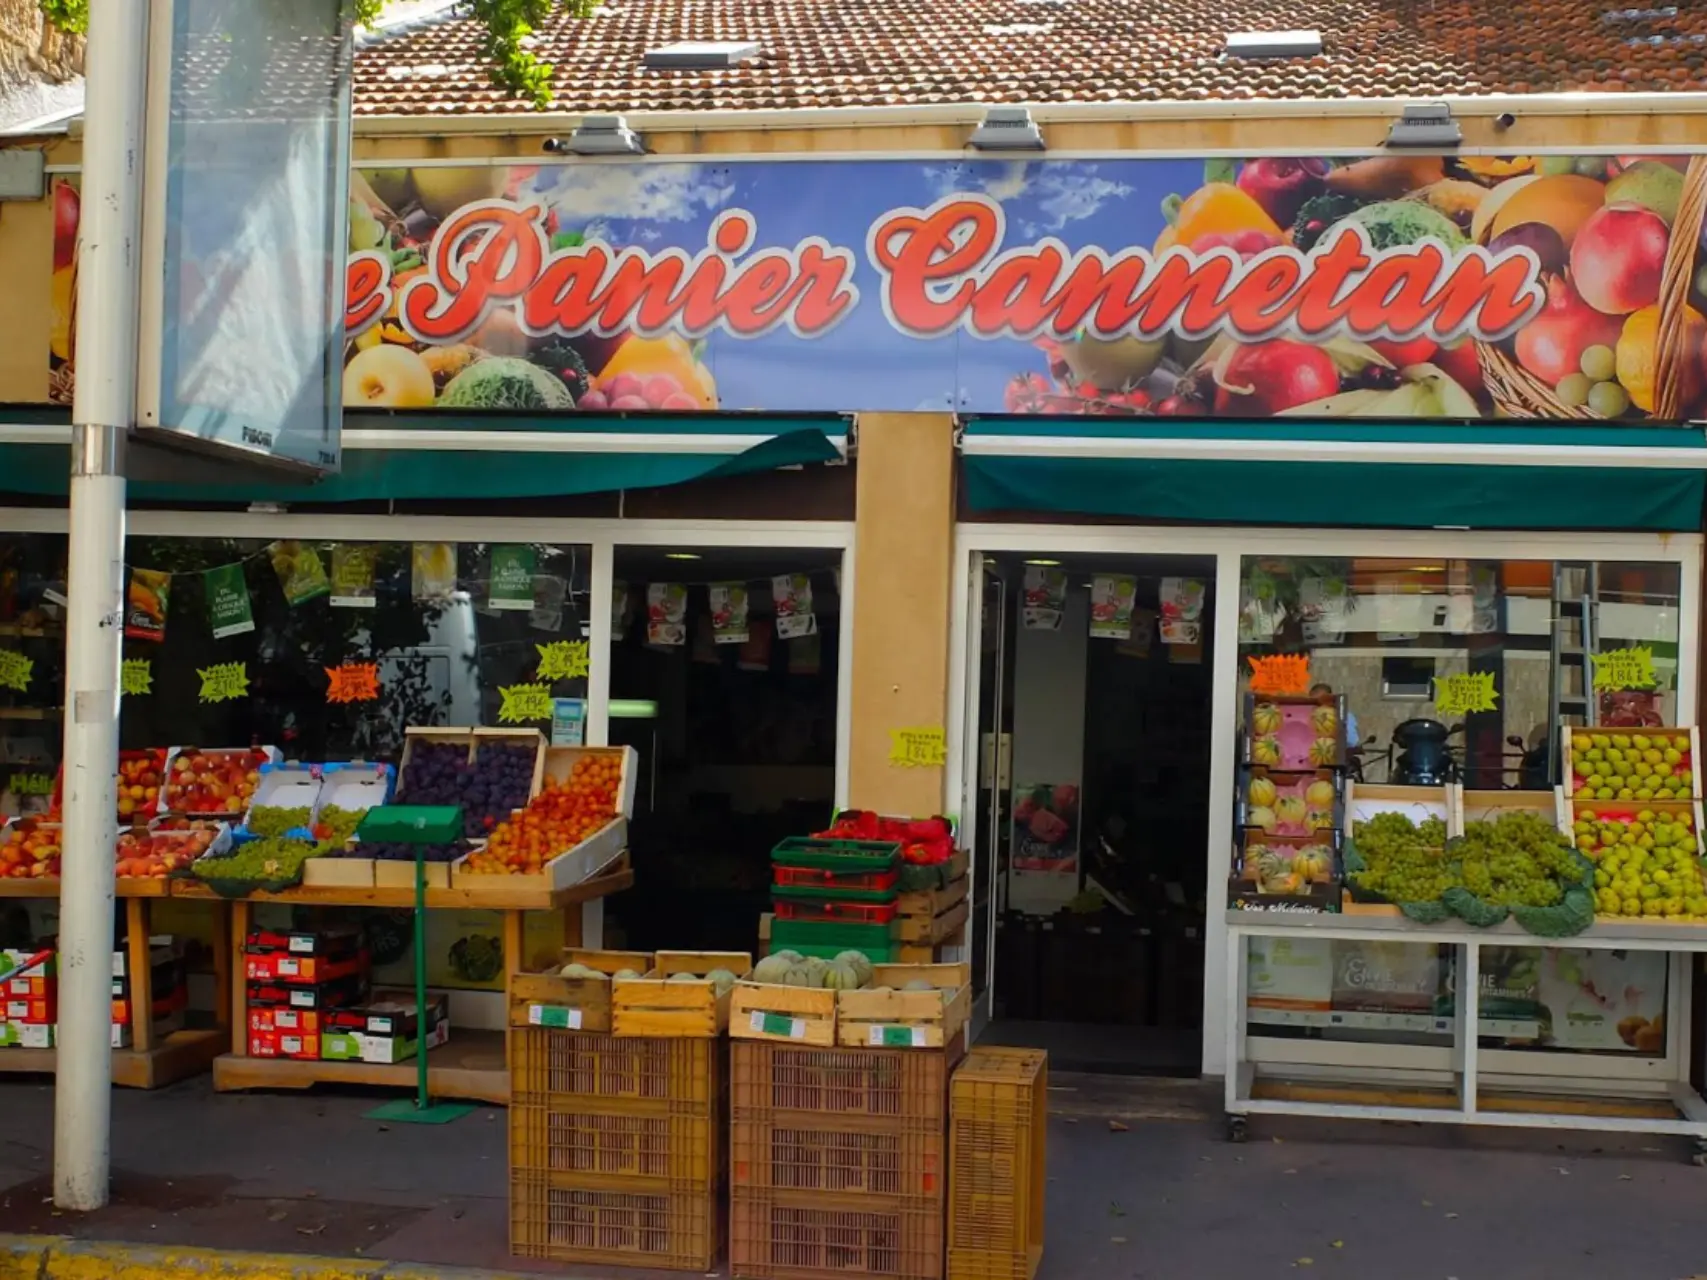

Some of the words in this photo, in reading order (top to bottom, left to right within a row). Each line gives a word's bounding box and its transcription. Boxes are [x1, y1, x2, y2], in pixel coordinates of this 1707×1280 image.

[346, 250, 391, 338] e
[404, 200, 858, 340] Panier
[868, 193, 1545, 340] Cannetan
